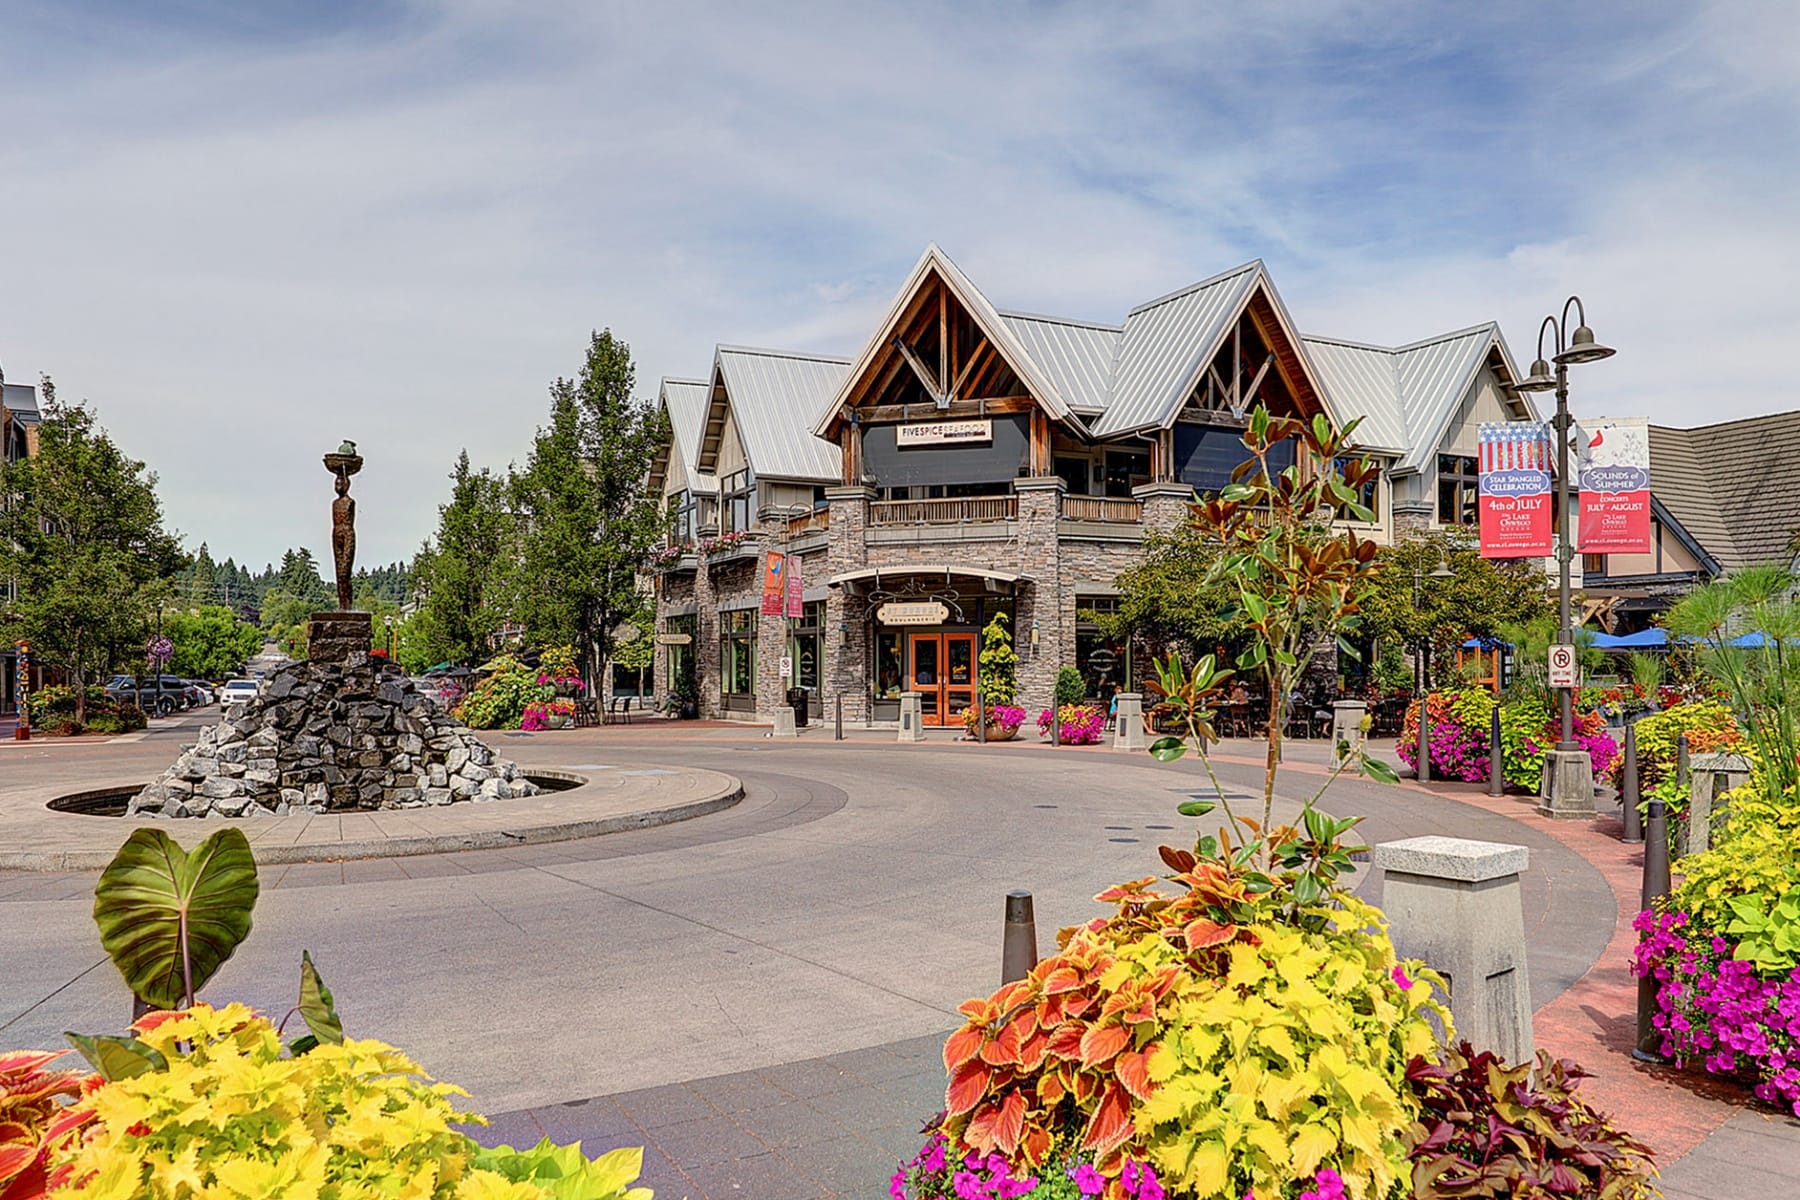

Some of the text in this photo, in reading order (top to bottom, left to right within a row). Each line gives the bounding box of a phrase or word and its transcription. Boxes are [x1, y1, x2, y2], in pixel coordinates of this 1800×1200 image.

[1507, 475, 1542, 483] SPANGLED
[1590, 471, 1639, 480] SOUNDS of
[1489, 483, 1542, 491] CELEBRATION
[1594, 480, 1635, 489] SUMMER
[1489, 499, 1543, 512] 4th of JULY
[1586, 503, 1605, 513] JULY
[1610, 502, 1644, 511] AUGUST
